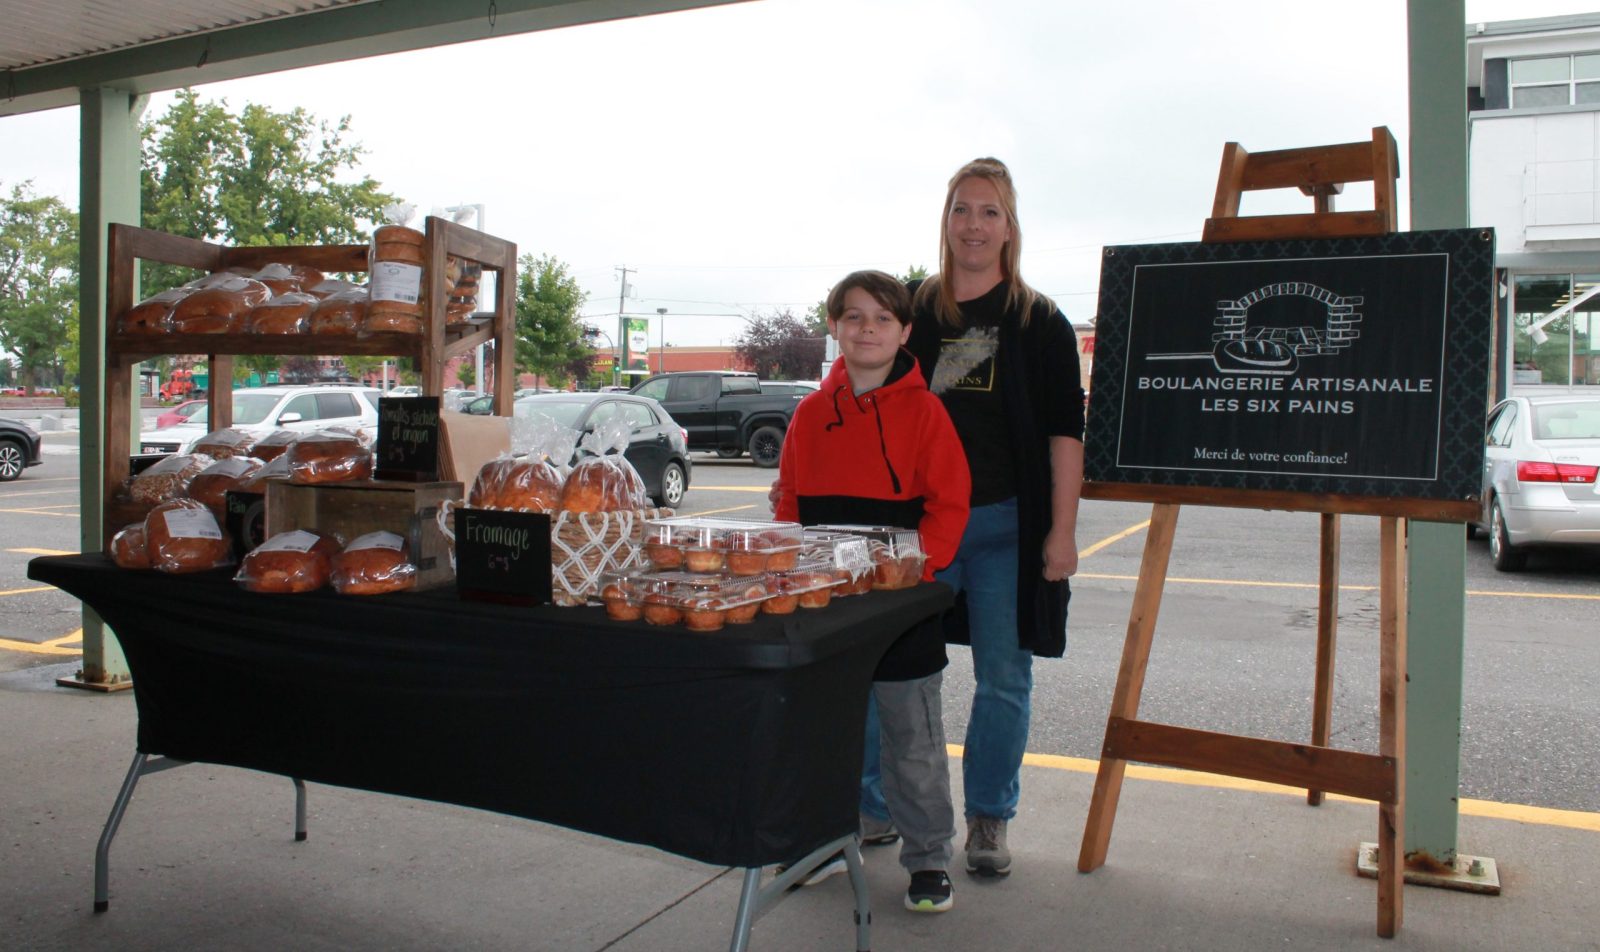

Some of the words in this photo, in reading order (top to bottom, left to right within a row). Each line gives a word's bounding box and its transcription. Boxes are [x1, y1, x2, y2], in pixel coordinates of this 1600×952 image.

[1138, 376, 1285, 392] BOULANGERIE
[1291, 377, 1434, 393] ARTISANALE
[1201, 398, 1239, 412] LES
[1247, 399, 1280, 413] SIX
[1288, 399, 1356, 414] PAINS
[1194, 447, 1228, 460] Merci
[1231, 449, 1246, 461] de
[1249, 450, 1280, 462] votre
[1283, 450, 1348, 464] confiance!
[465, 515, 530, 560] Fromage
